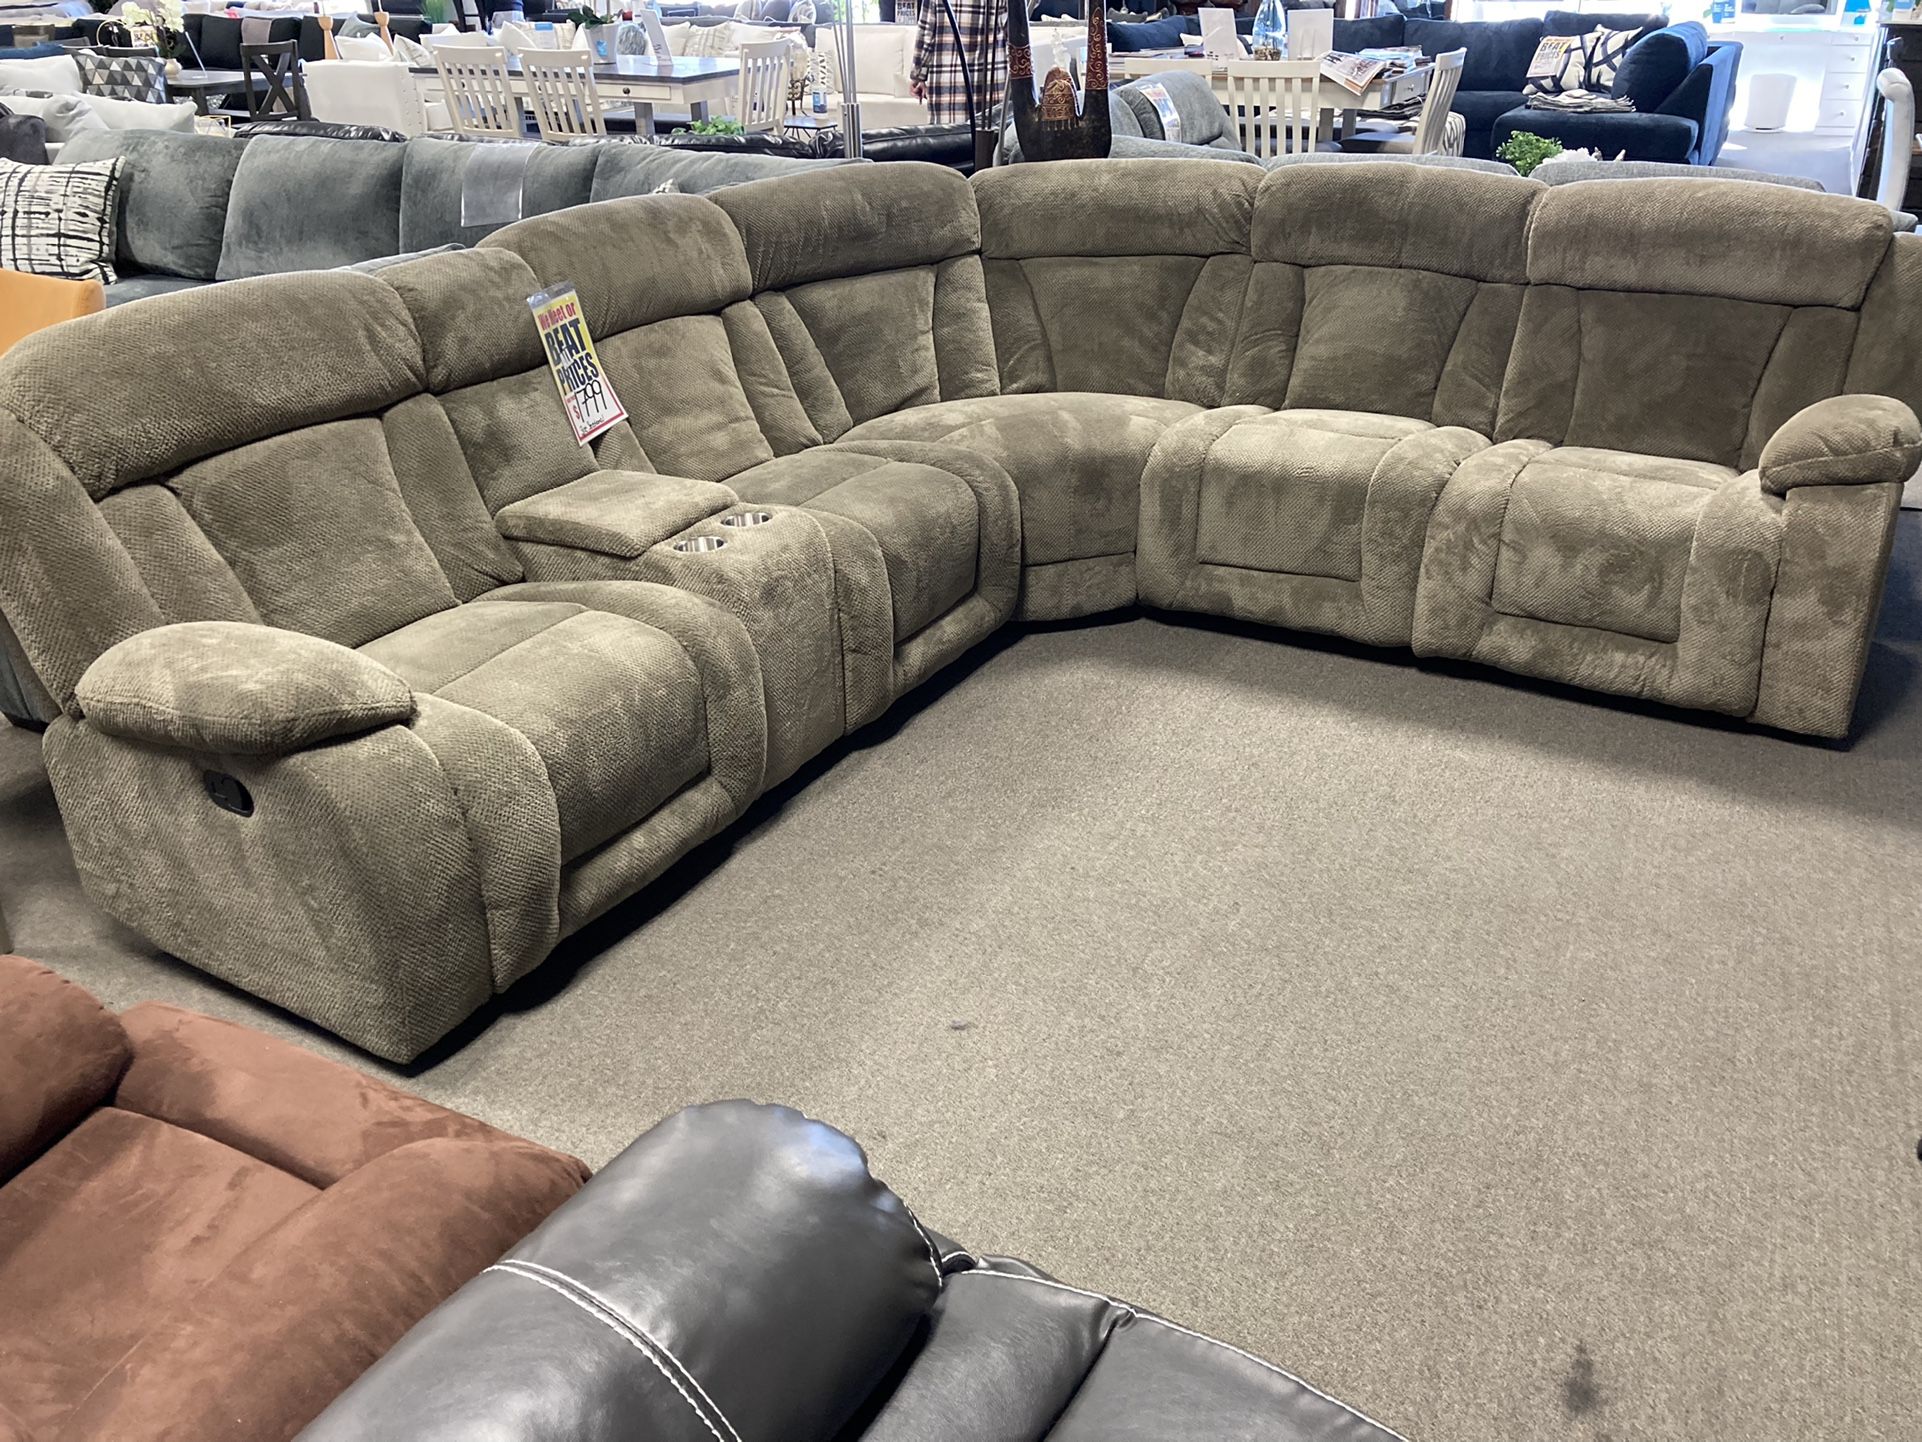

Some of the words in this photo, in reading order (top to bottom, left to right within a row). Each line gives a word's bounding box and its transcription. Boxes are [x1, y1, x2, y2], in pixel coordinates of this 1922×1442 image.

[565, 302, 576, 317] or
[544, 317, 586, 366] BEAT
[556, 352, 599, 396] PRICES
